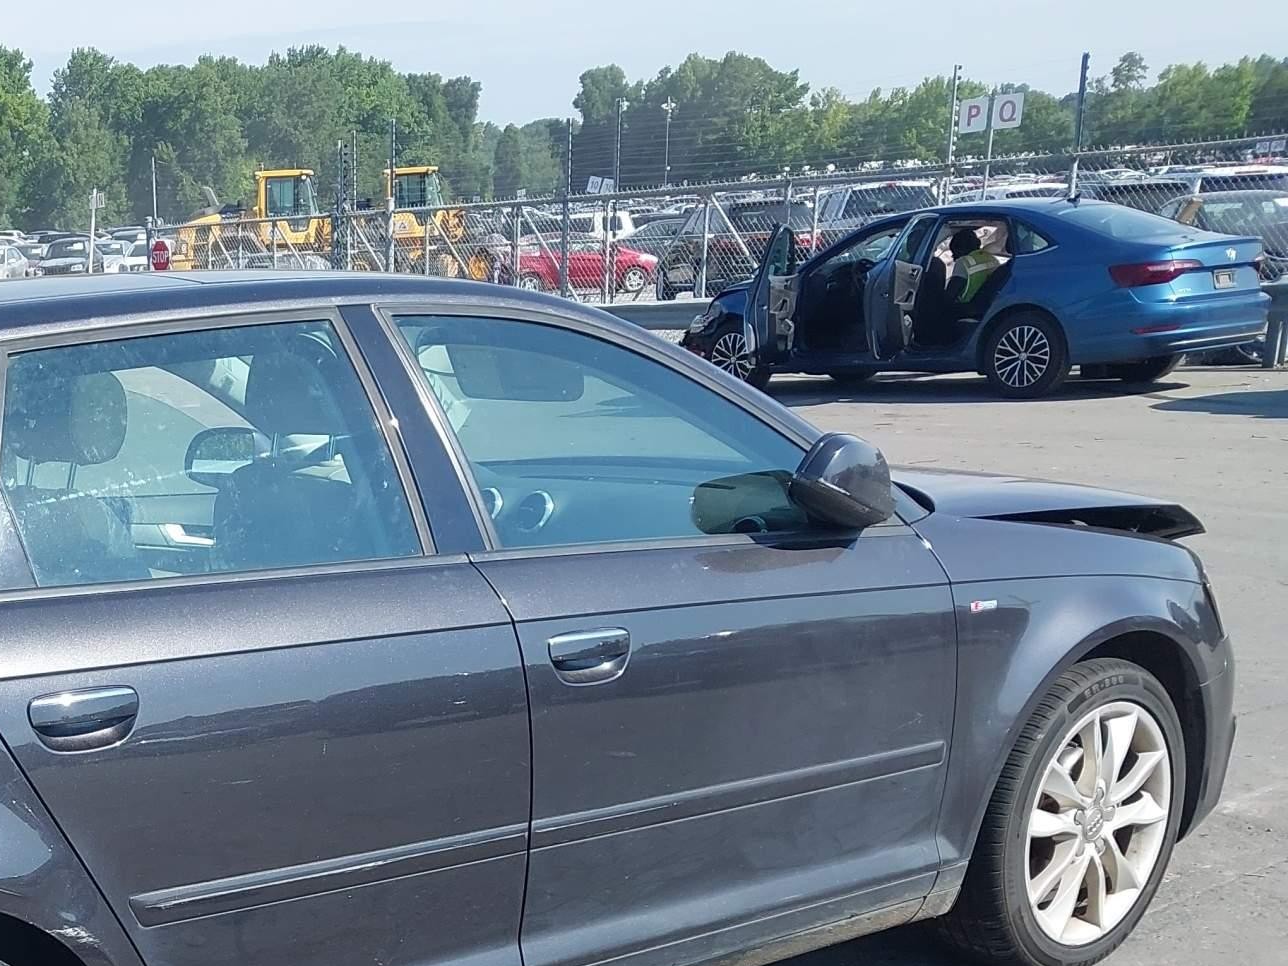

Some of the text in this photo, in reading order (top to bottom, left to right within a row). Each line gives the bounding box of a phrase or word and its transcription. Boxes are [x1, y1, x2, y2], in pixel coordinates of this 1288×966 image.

[967, 104, 981, 127] P
[998, 100, 1017, 123] Q
[152, 250, 169, 264] STOP
